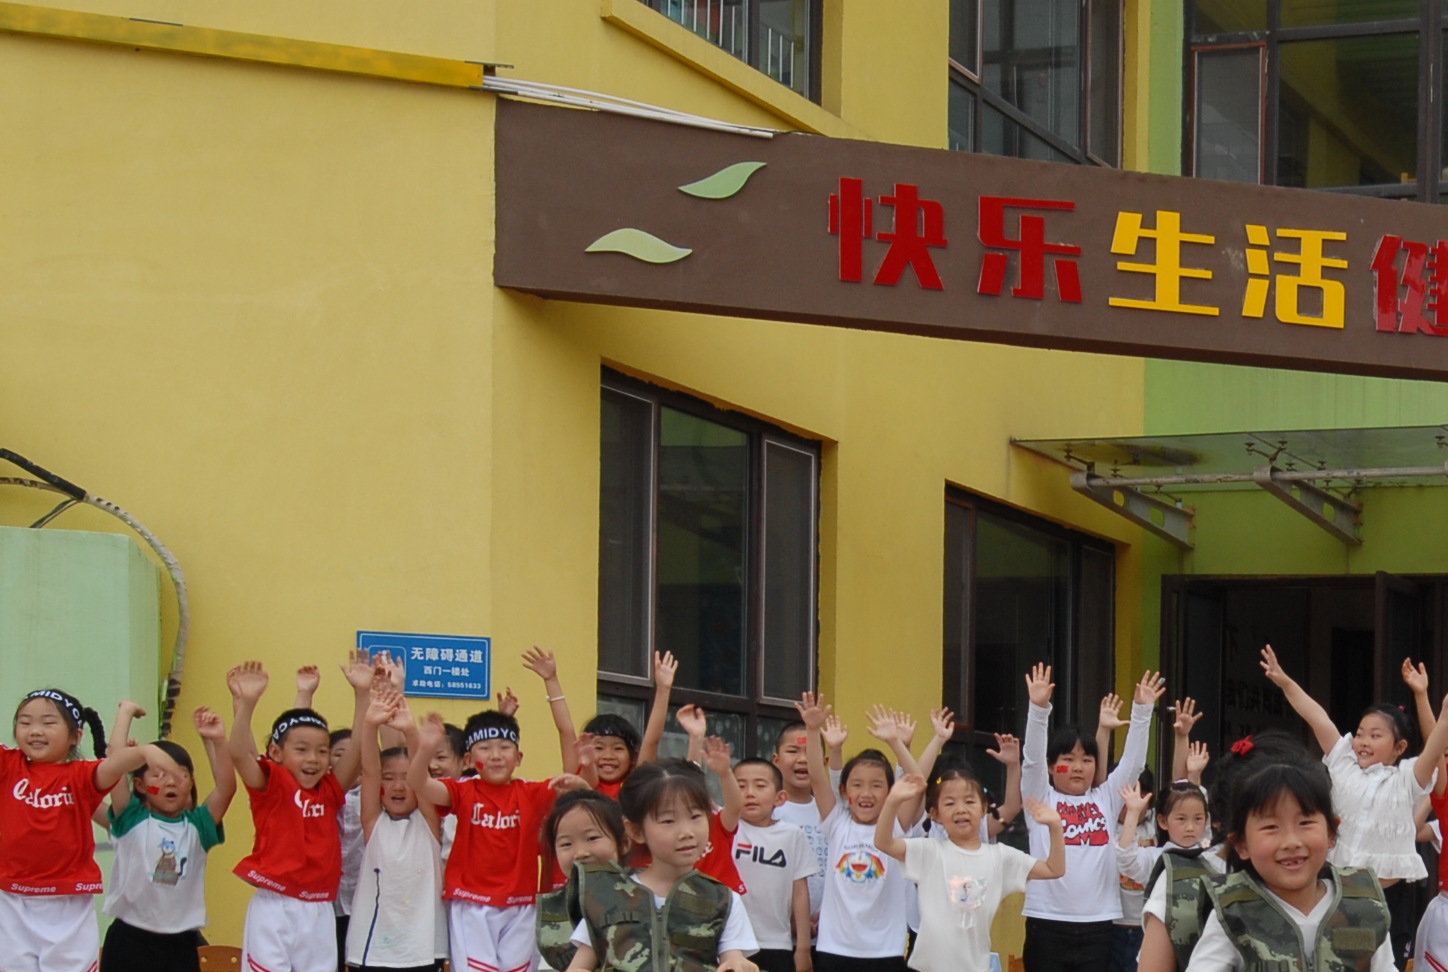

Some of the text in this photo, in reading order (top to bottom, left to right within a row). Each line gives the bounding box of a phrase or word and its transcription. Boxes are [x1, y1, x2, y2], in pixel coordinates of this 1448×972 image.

[411, 647, 483, 663] 无障碍通道
[735, 843, 787, 869] FILA
[10, 882, 57, 893] Supreme
[247, 870, 287, 892] Supreme
